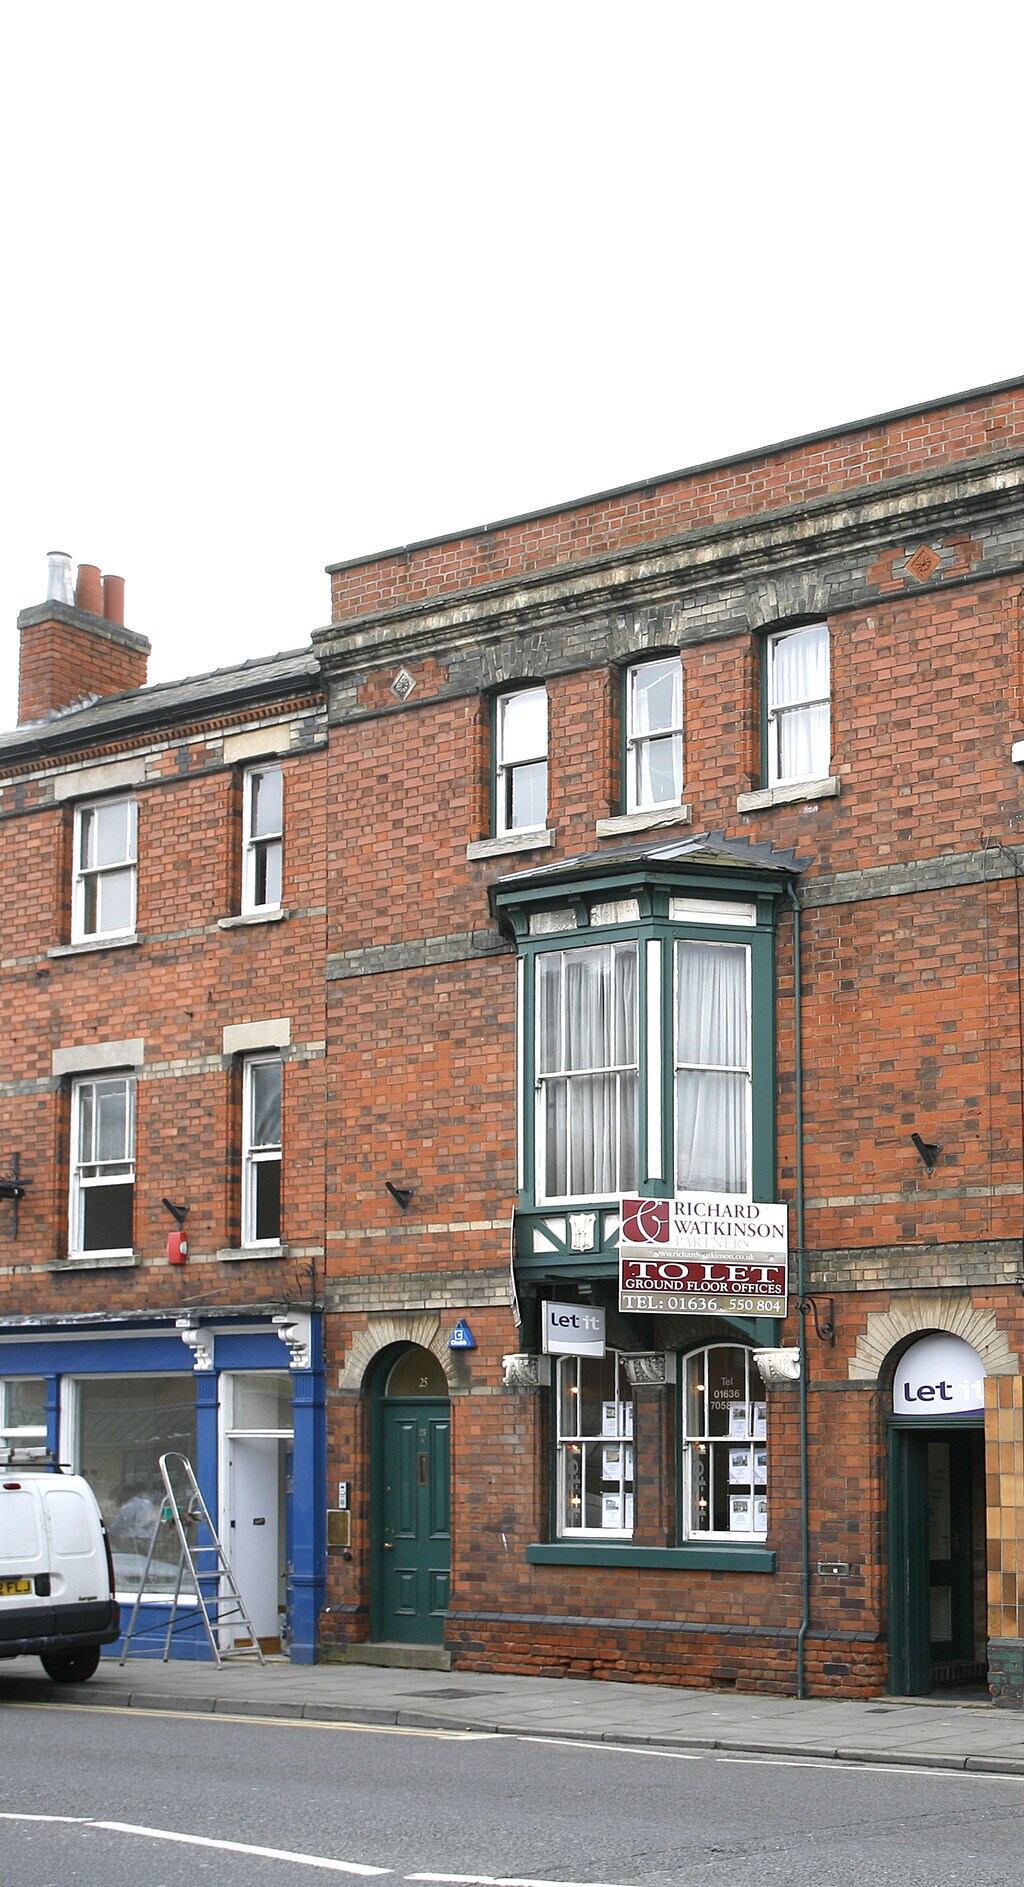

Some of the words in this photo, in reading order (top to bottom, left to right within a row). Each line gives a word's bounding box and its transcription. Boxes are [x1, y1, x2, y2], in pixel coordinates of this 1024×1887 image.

[674, 1201, 760, 1219] RICHARD
[673, 1219, 785, 1239] WATKINSON
[675, 1235, 752, 1249] PARTNERS
[628, 1261, 689, 1280] TO
[700, 1264, 779, 1283] LET
[625, 1278, 684, 1291] GROUND
[686, 1280, 729, 1293] FLOOR
[731, 1282, 782, 1294] OFFICES
[622, 1295, 664, 1310] TEL:
[667, 1296, 718, 1311] 01636
[729, 1298, 753, 1311] 550
[756, 1299, 781, 1313] 804
[582, 1315, 600, 1331] it
[418, 1377, 428, 1388] 25
[720, 1376, 733, 1386] Tel
[713, 1389, 740, 1399] 01636
[7, 1581, 30, 1593] FLJ
